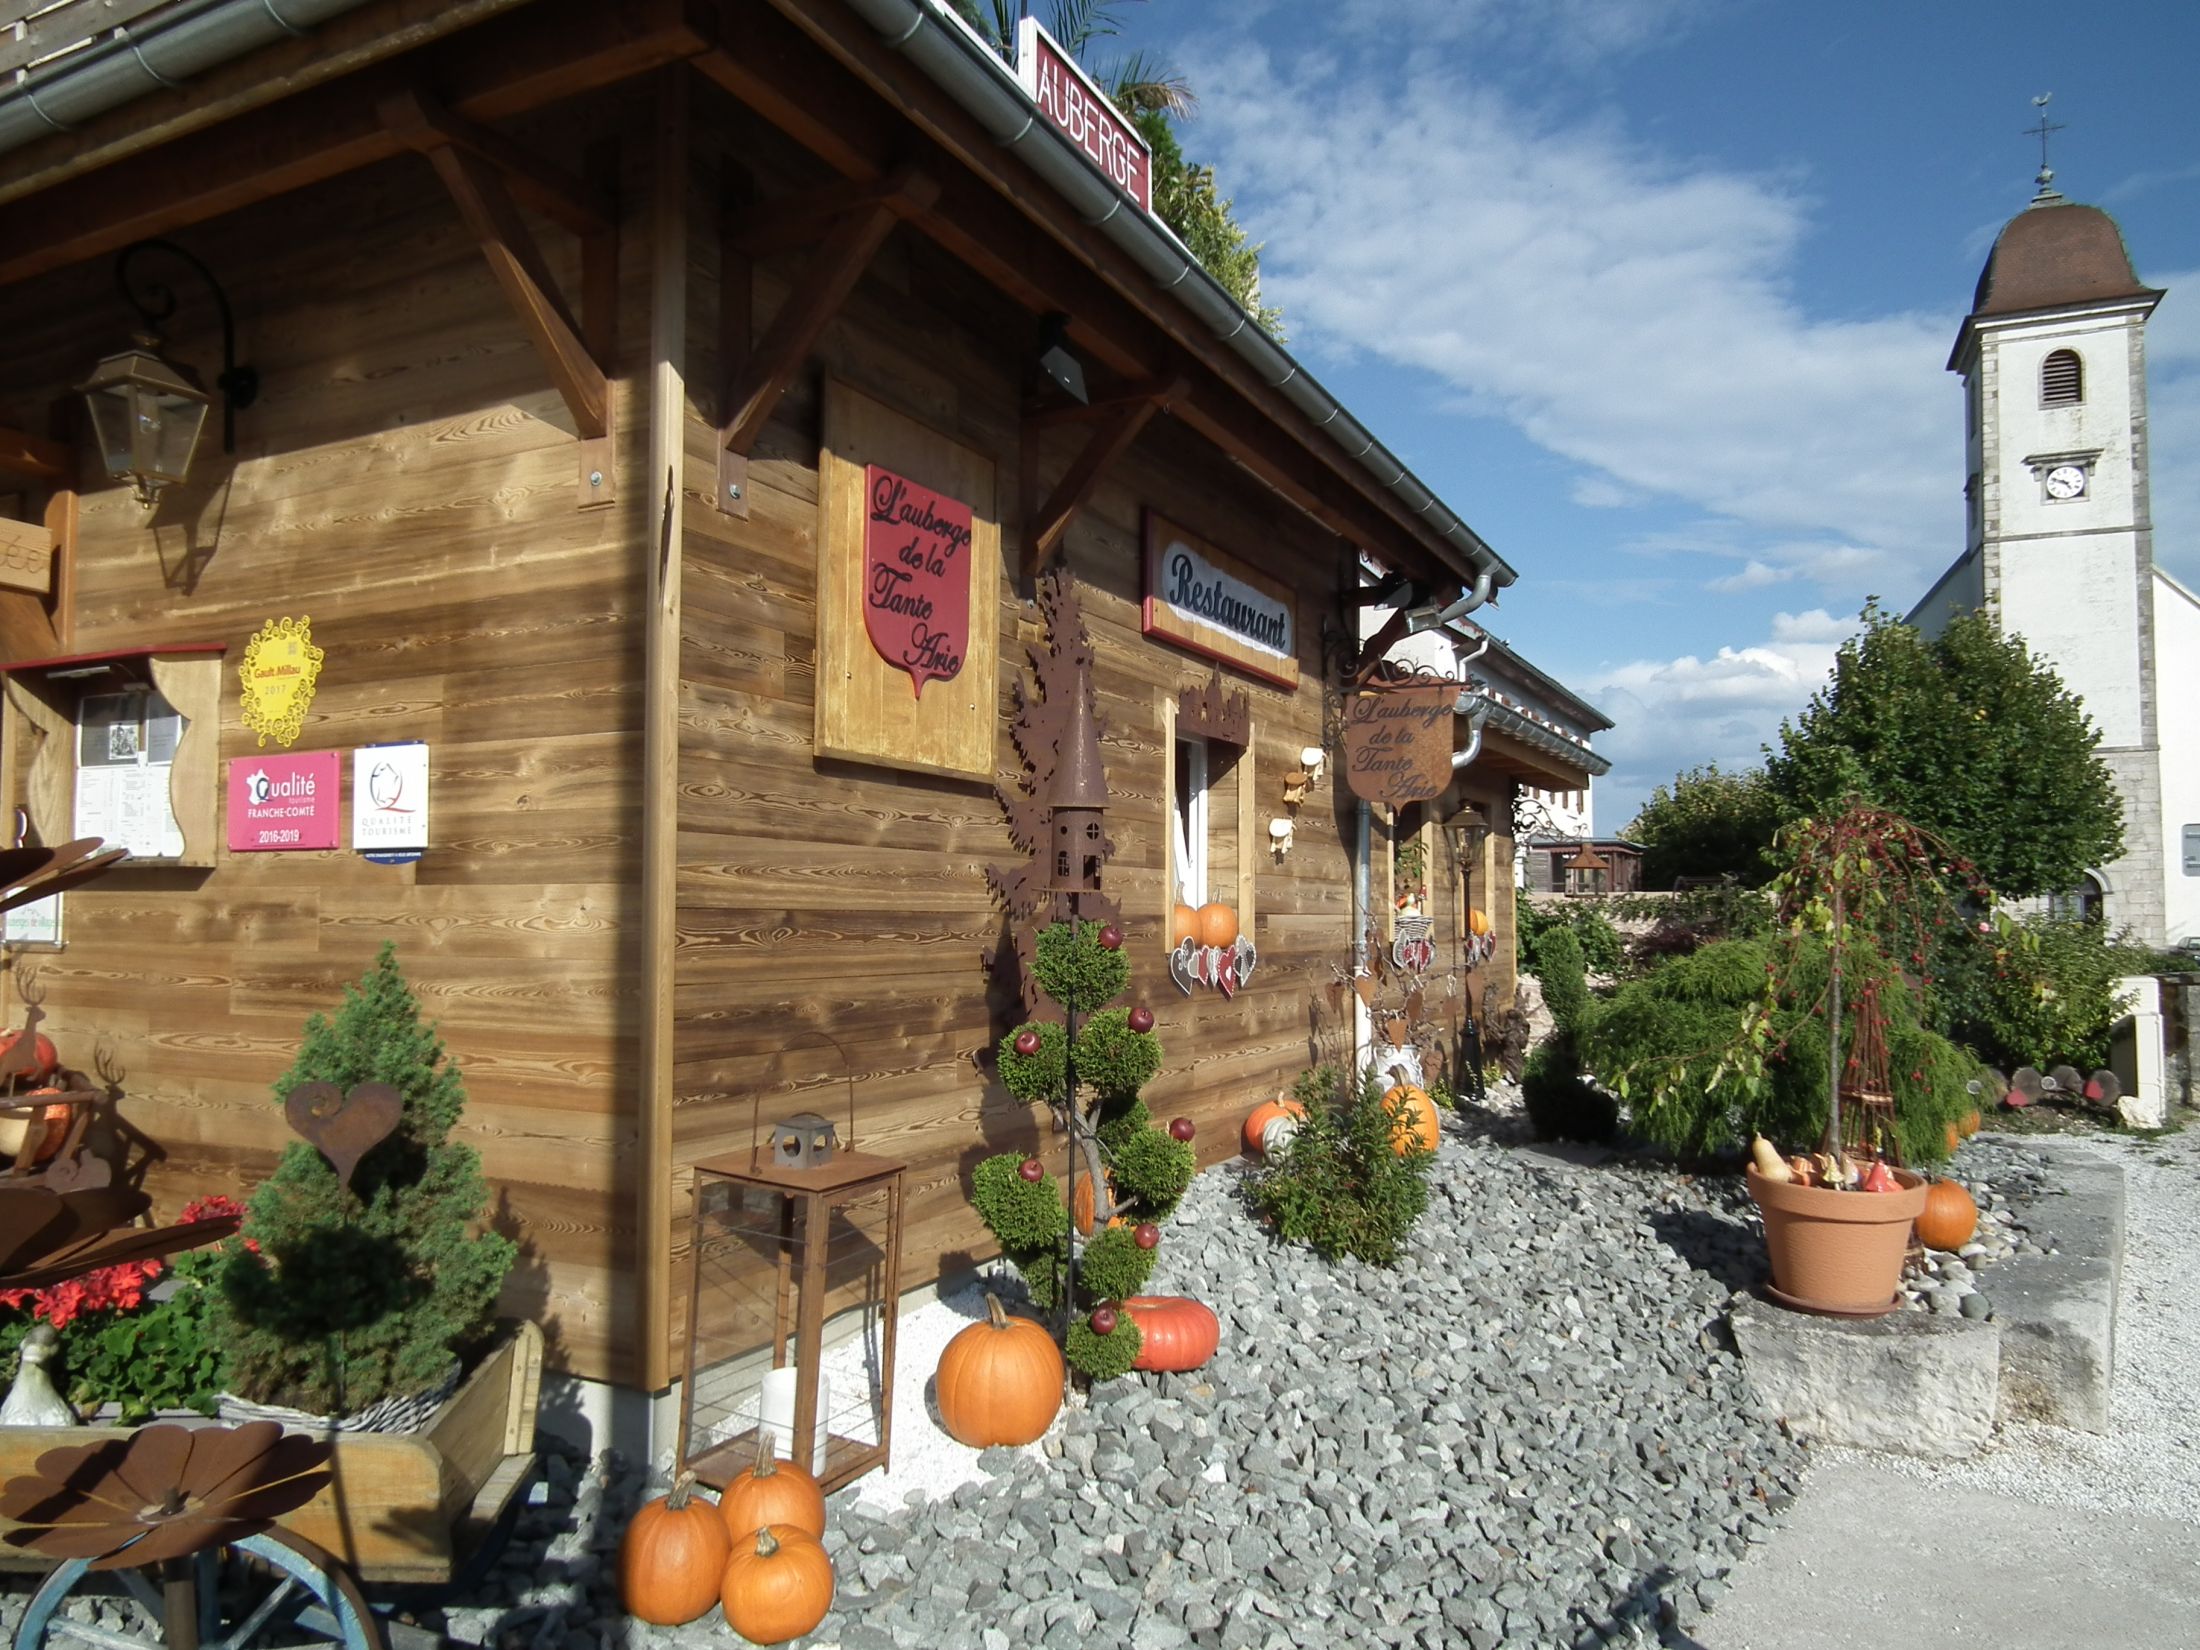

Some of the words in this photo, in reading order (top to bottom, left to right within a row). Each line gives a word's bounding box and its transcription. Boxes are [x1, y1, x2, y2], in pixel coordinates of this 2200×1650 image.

[1038, 56, 1140, 203] AUBERGE
[871, 475, 972, 557] L'auberge
[899, 537, 923, 570] de
[925, 543, 945, 578] la
[869, 563, 933, 620] Tante
[1170, 554, 1286, 649] Restaurant
[903, 622, 960, 674] Arie
[1351, 697, 1453, 728] L'auberge
[1369, 725, 1392, 745] de
[1395, 726, 1415, 744] la
[1352, 746, 1413, 772] Tante
[256, 771, 316, 802] Qualité
[1379, 771, 1438, 798] Arie
[259, 829, 300, 844] 2016-2019
[362, 826, 412, 837] TOURISME
